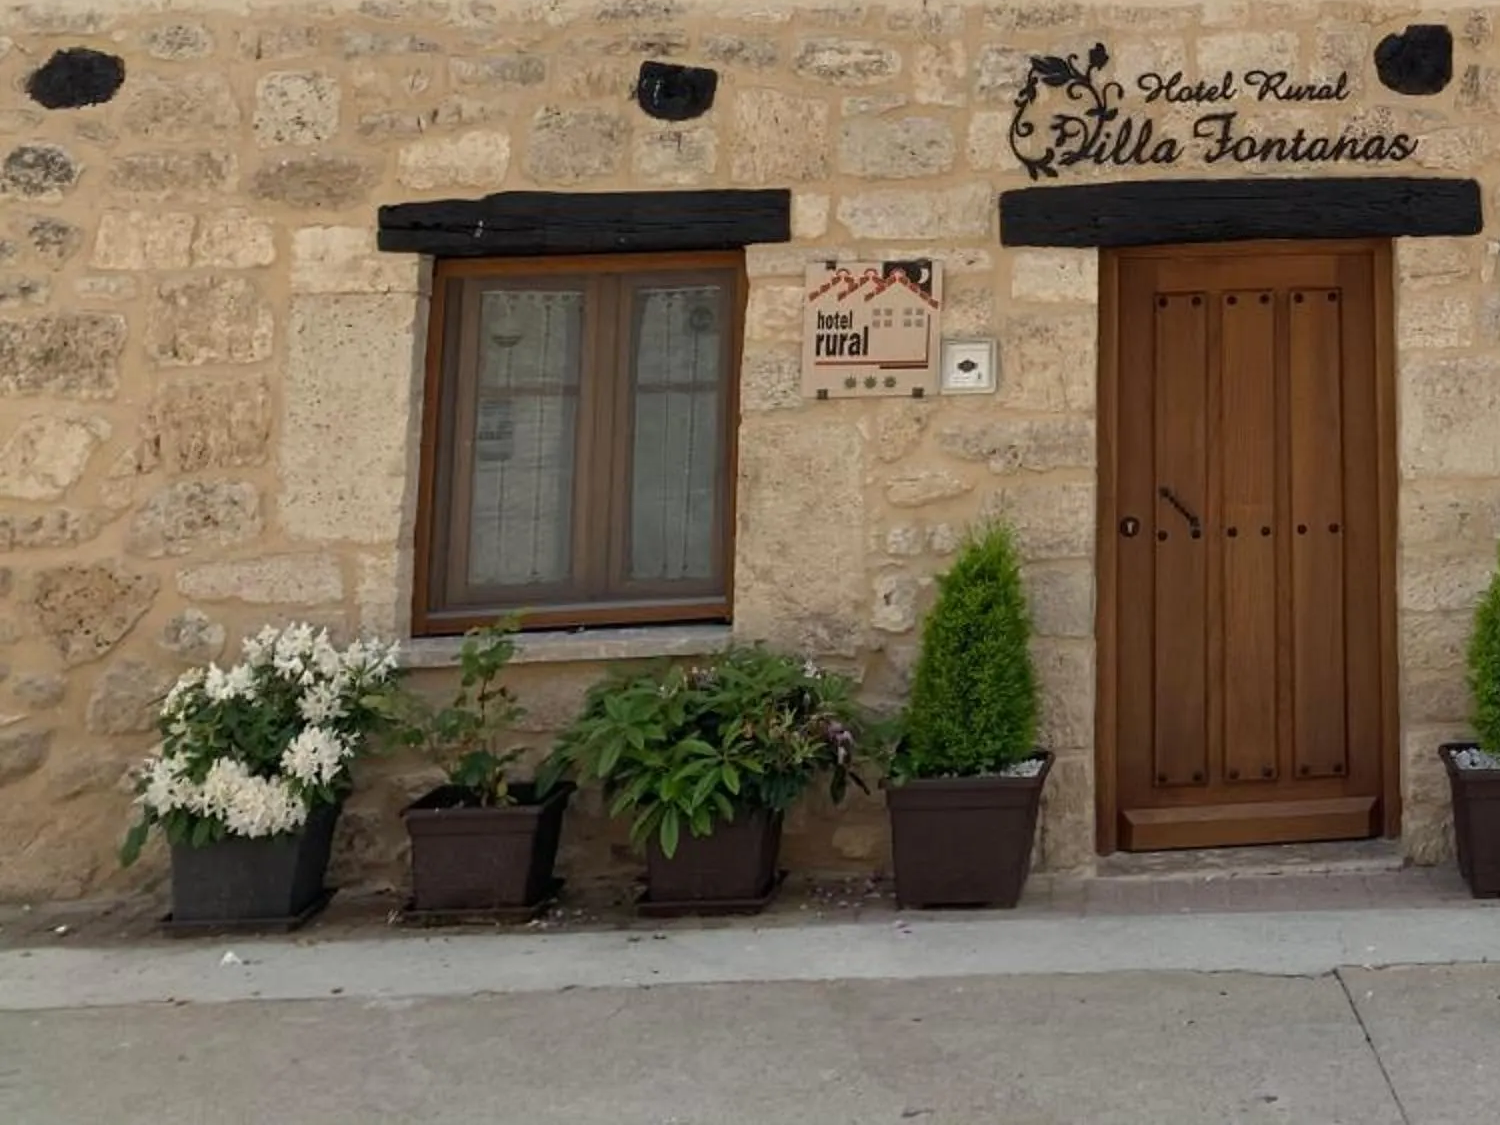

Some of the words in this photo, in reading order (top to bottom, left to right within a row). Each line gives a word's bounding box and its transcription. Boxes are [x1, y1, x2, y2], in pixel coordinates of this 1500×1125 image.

[1137, 71, 1237, 103] Hotel
[1244, 70, 1351, 102] Rural
[1049, 114, 1184, 166] Villa
[1193, 111, 1419, 163] Fontanas
[817, 310, 853, 330] hotel
[815, 326, 869, 356] rural
